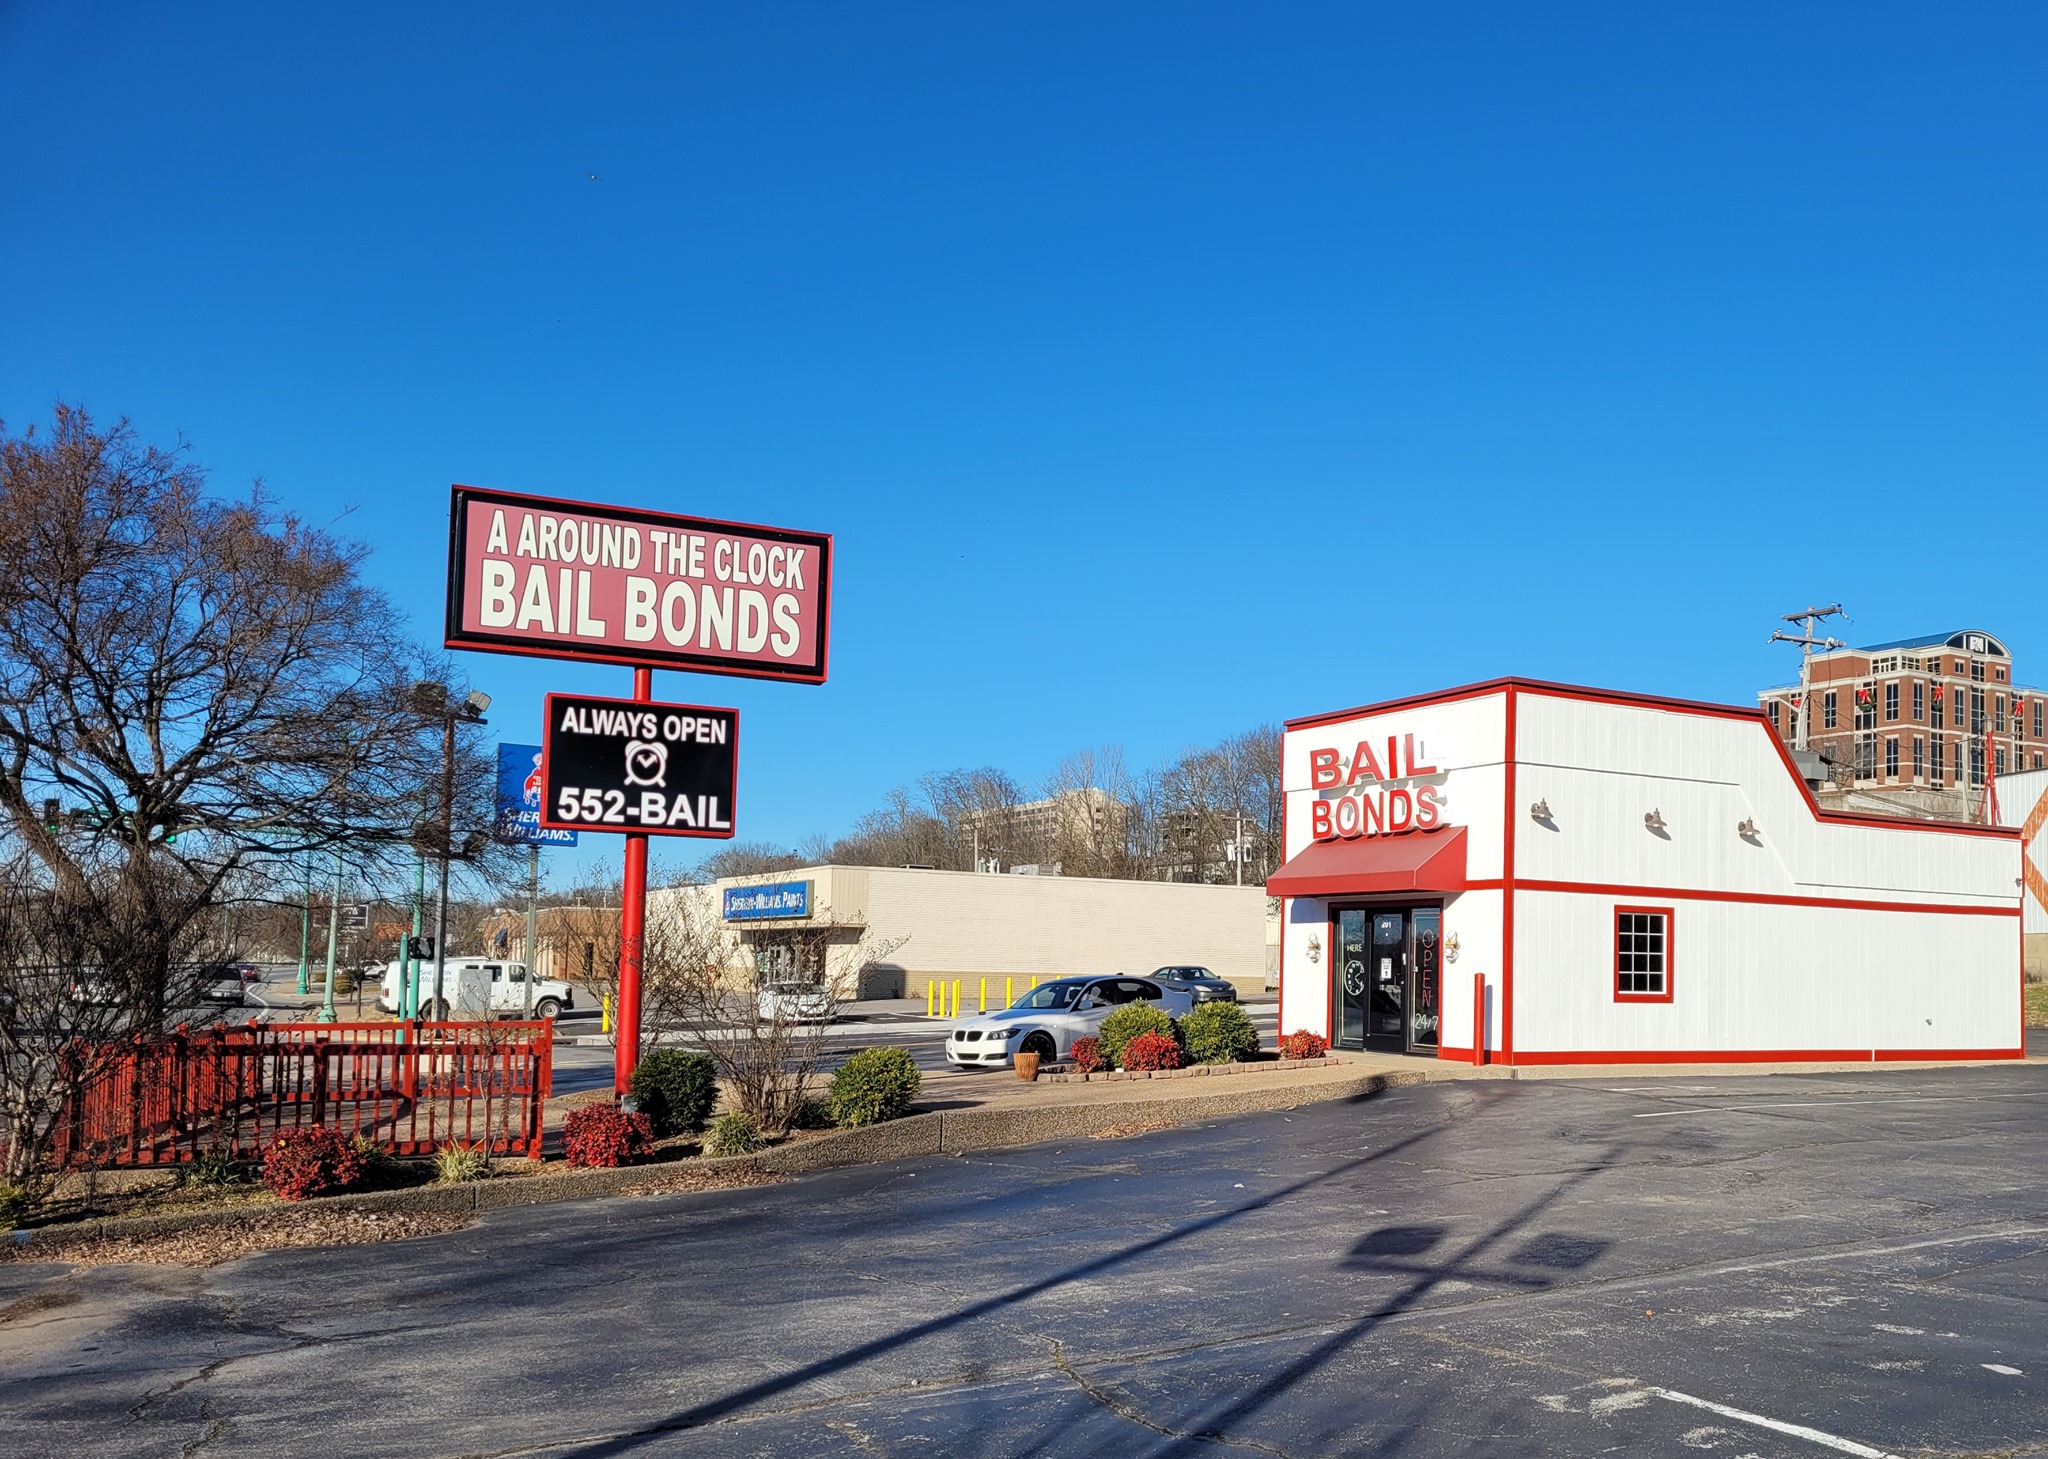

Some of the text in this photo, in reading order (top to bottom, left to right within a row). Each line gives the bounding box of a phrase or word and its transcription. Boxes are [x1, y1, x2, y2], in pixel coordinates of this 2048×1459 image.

[486, 509, 806, 591] A AROUND THE CLOCK
[480, 558, 802, 658] BAIL BONDS
[560, 707, 727, 745] ALWAYS OPEN
[1309, 733, 1437, 791] BAIL
[557, 786, 731, 829] 552-BAIL
[1312, 785, 1439, 840] BONDS
[782, 891, 803, 908] PAINTS
[1422, 929, 1435, 1008] OPEN
[1415, 1013, 1439, 1031] 24/7
